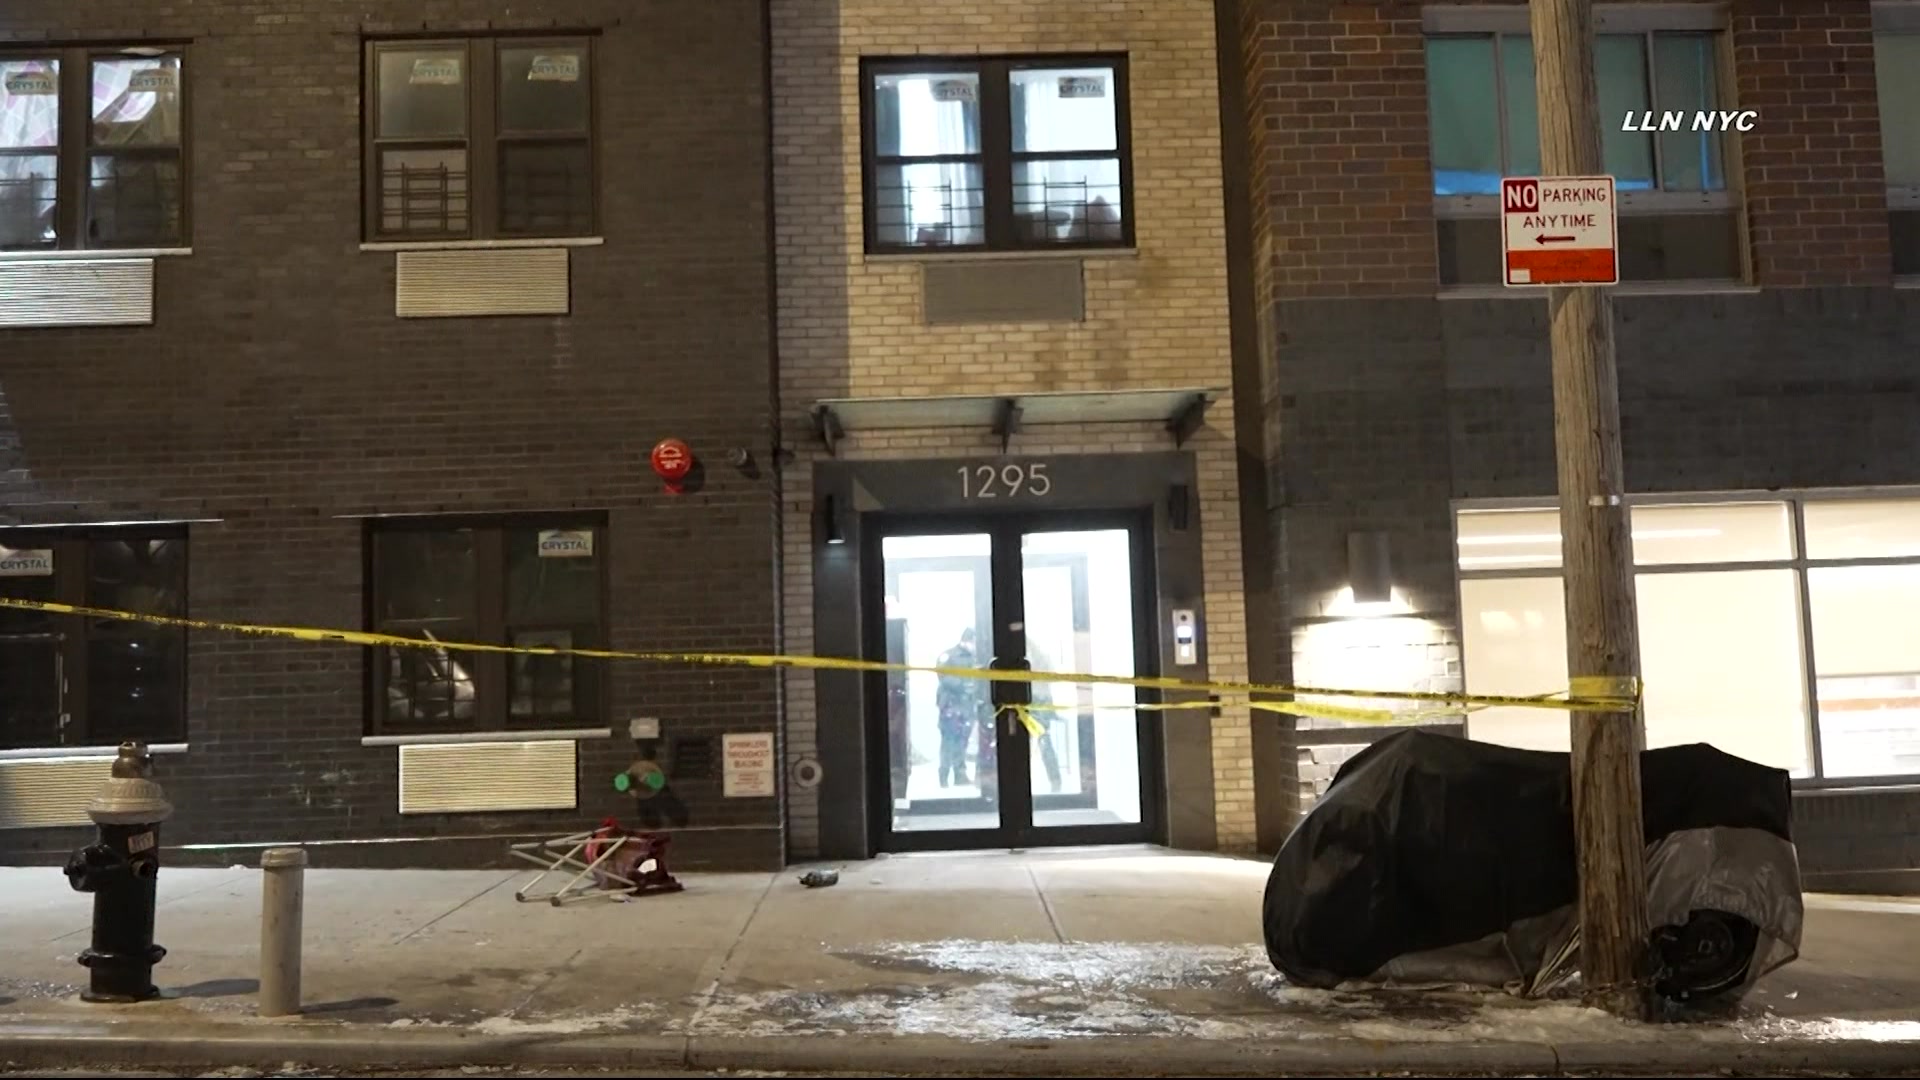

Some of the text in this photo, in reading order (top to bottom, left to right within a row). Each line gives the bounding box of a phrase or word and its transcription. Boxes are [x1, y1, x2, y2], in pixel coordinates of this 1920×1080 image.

[6, 80, 54, 90] CRYSTAL
[130, 76, 177, 87] CRYSTAL
[1506, 184, 1606, 209] NO PARKING
[1523, 214, 1597, 228] ANYTIME
[958, 464, 1051, 498] 1295
[541, 541, 589, 550] CRYSTAL
[0, 558, 49, 569] CRYSTAL
